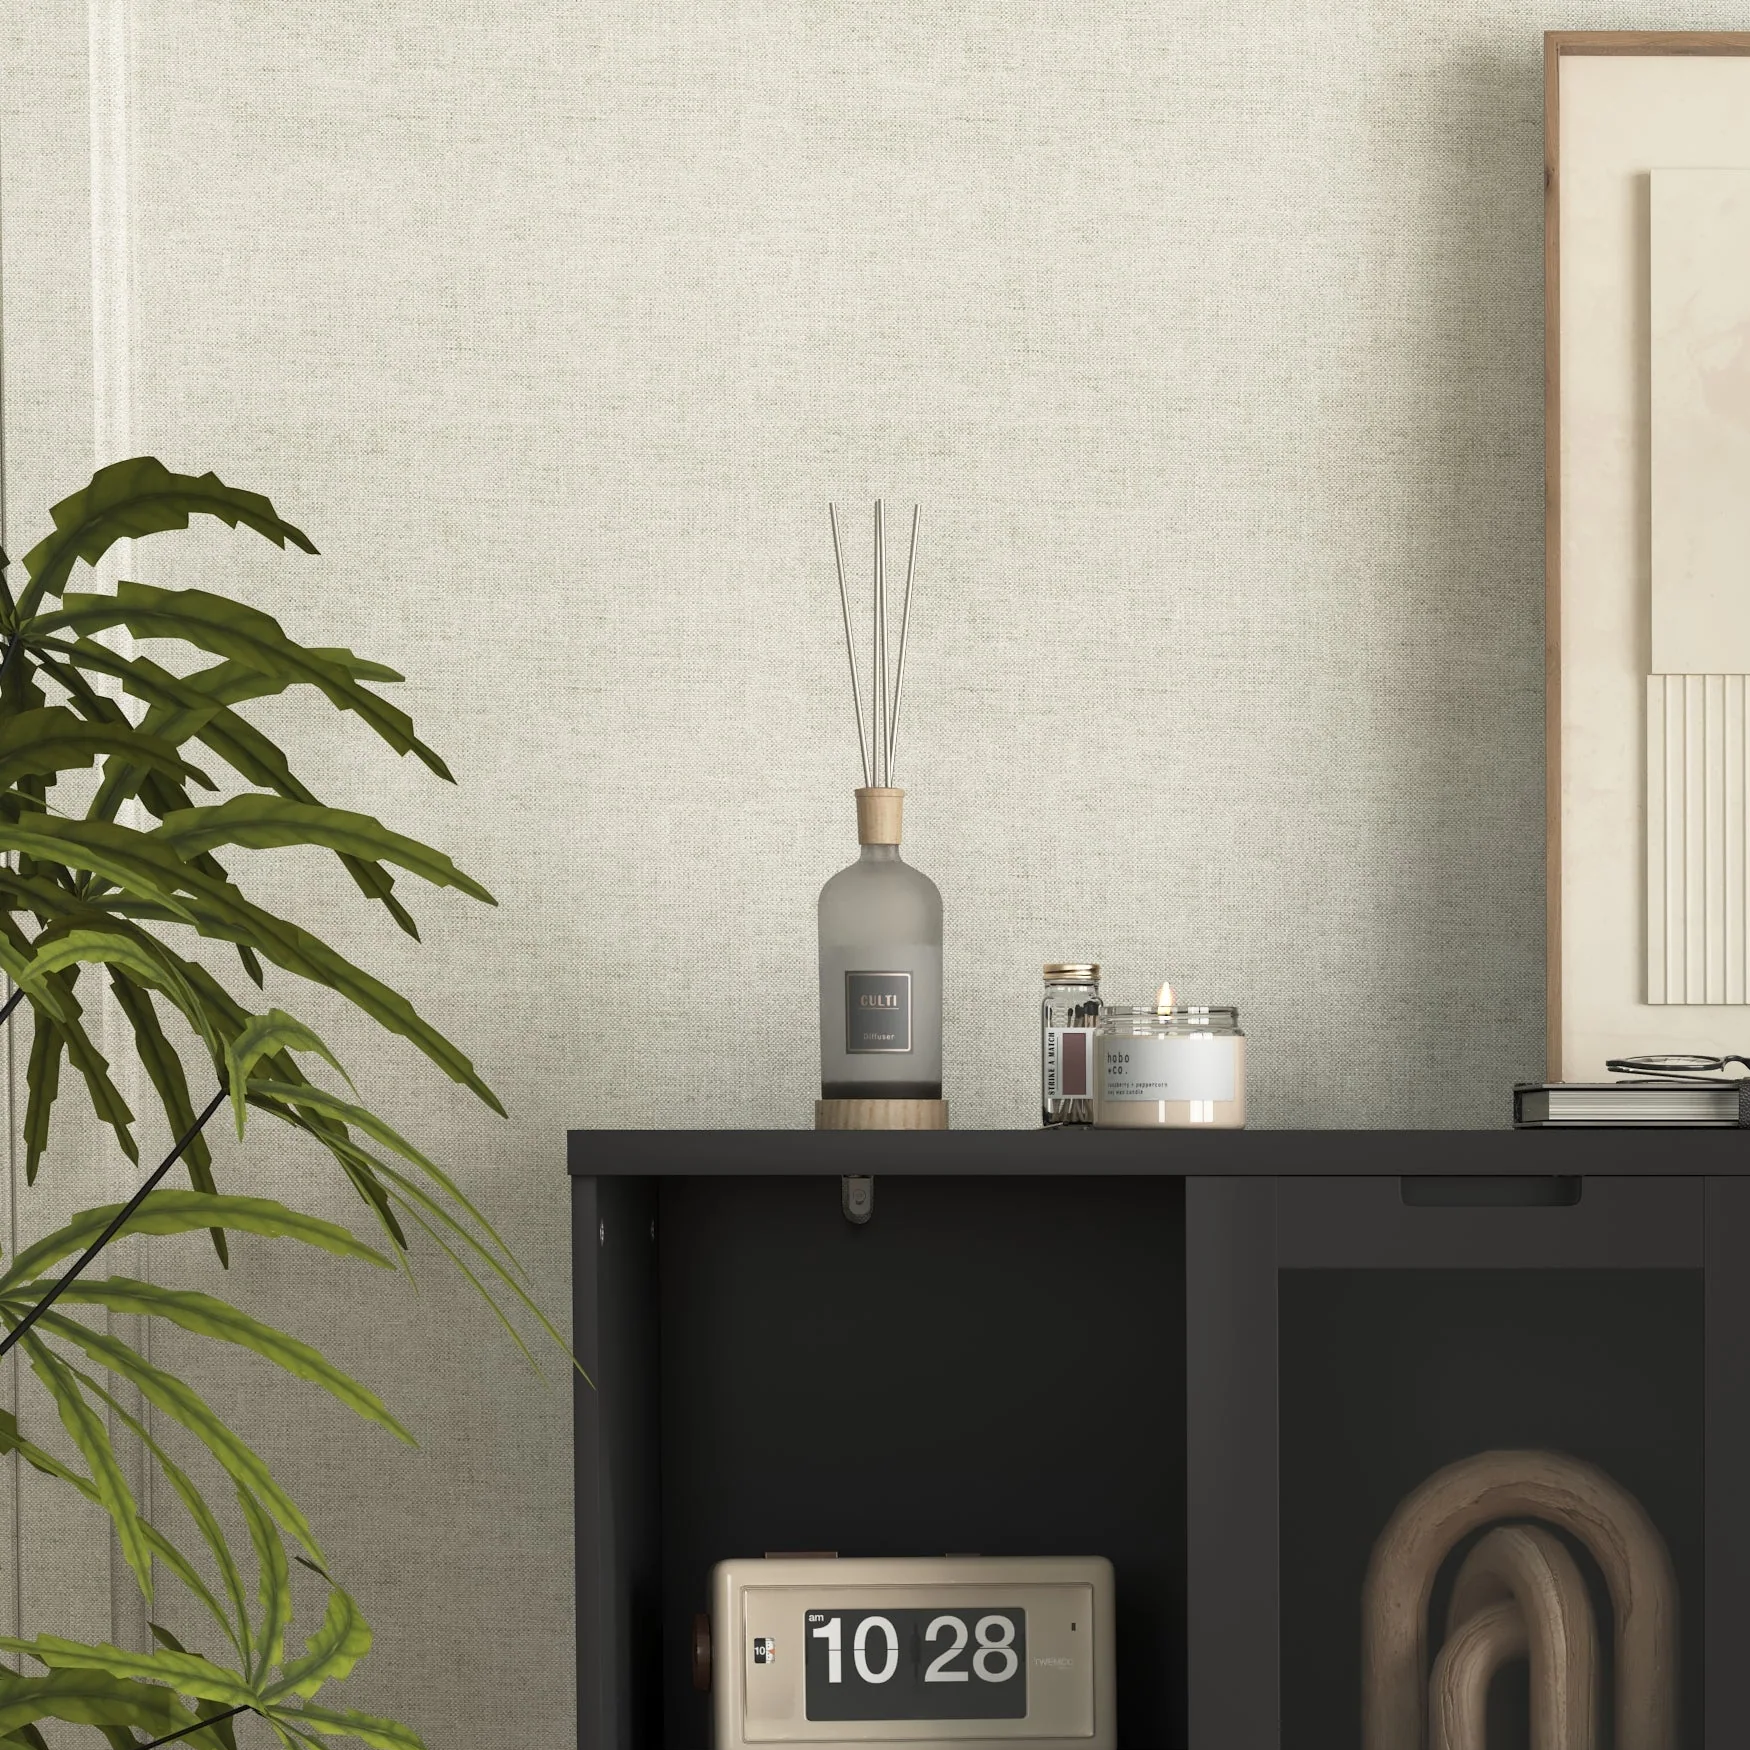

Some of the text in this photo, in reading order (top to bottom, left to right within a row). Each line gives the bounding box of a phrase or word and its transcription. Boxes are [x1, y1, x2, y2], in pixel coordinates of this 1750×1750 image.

[860, 994, 897, 1007] CULTI
[1047, 1032, 1056, 1058] MATCH
[1107, 1051, 1130, 1063] hobo
[1047, 1068, 1056, 1096] STRIKE
[808, 1613, 825, 1622] am
[754, 1646, 766, 1656] 10
[812, 1615, 1019, 1684] 10 28
